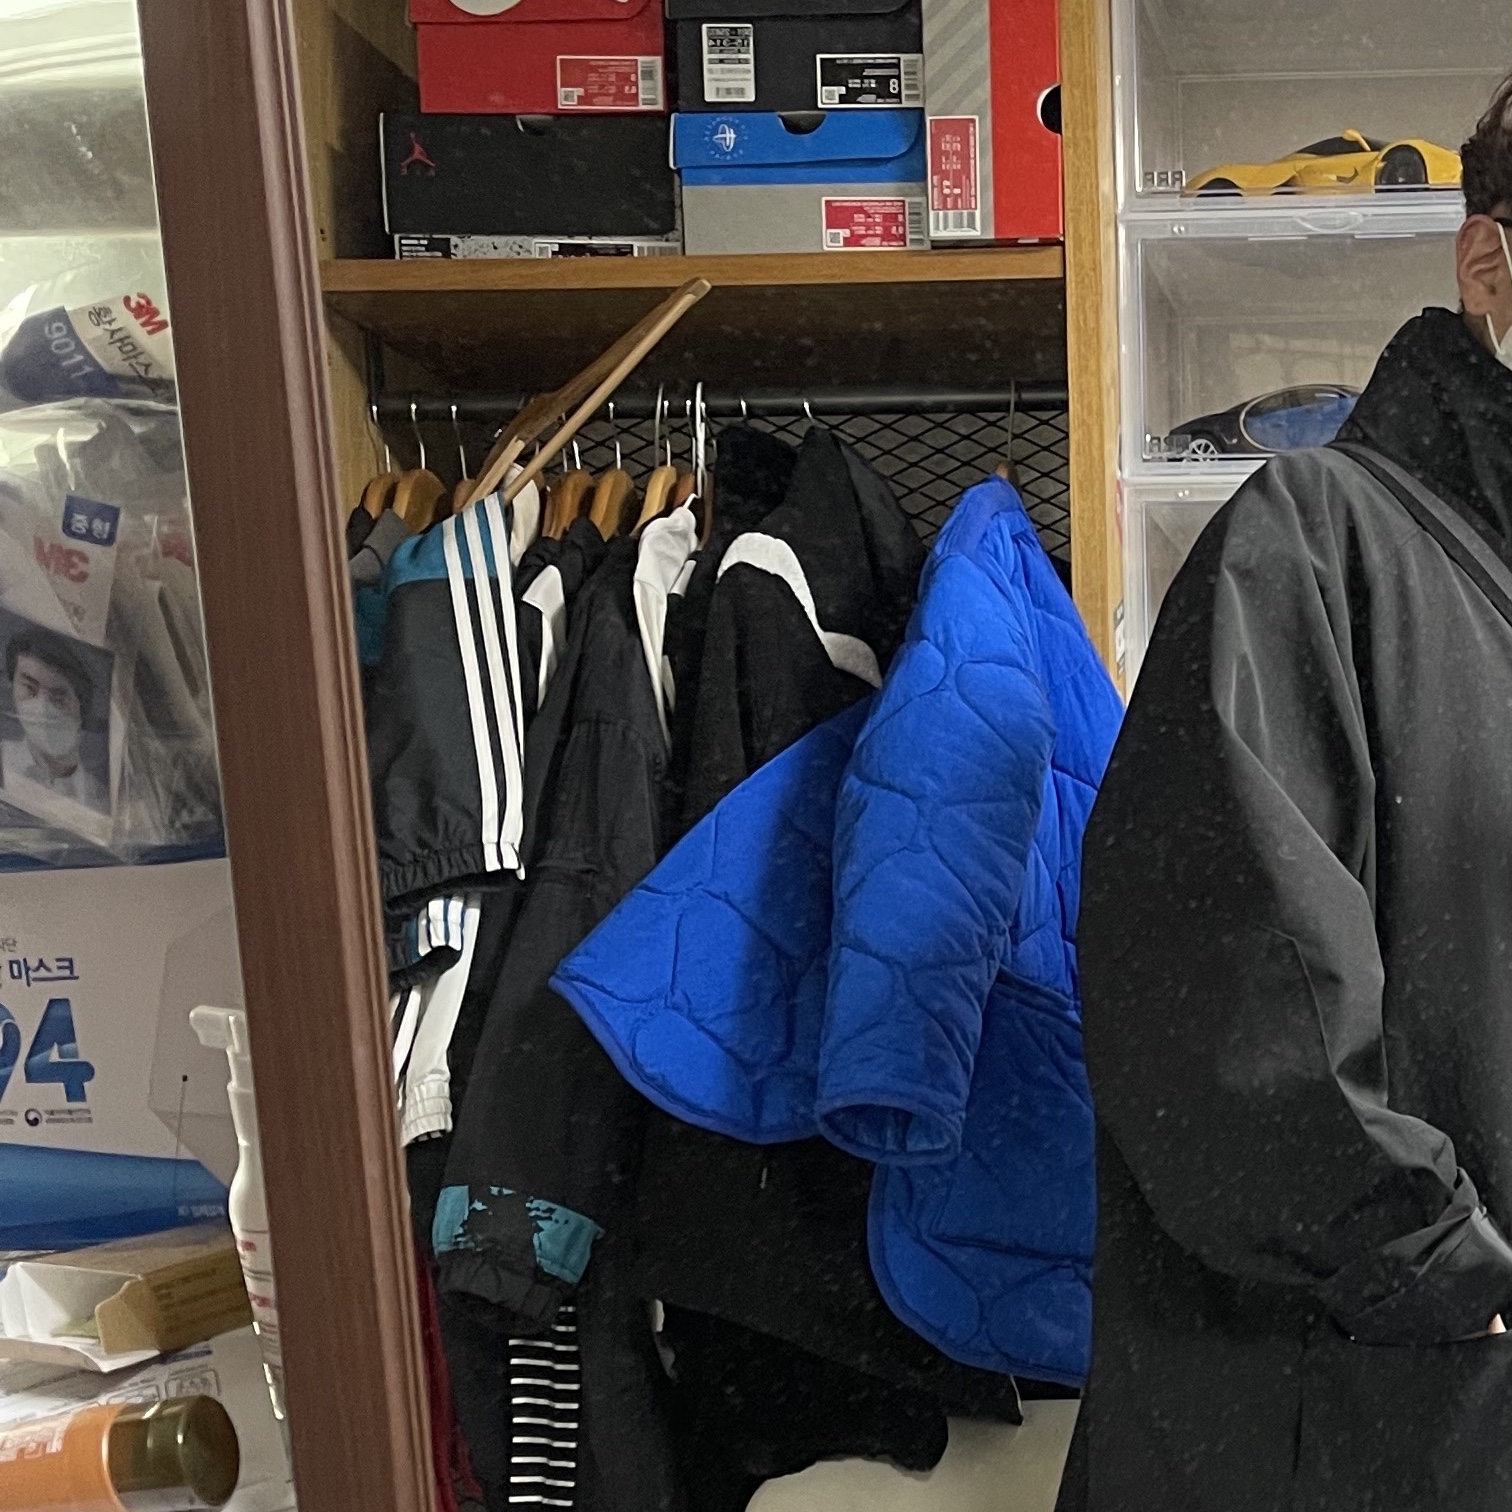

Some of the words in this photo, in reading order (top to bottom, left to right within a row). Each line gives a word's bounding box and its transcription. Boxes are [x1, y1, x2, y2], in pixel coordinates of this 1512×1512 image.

[122, 291, 169, 336] 3M
[44, 321, 95, 380] 9011
[9, 957, 79, 987] 마스크
